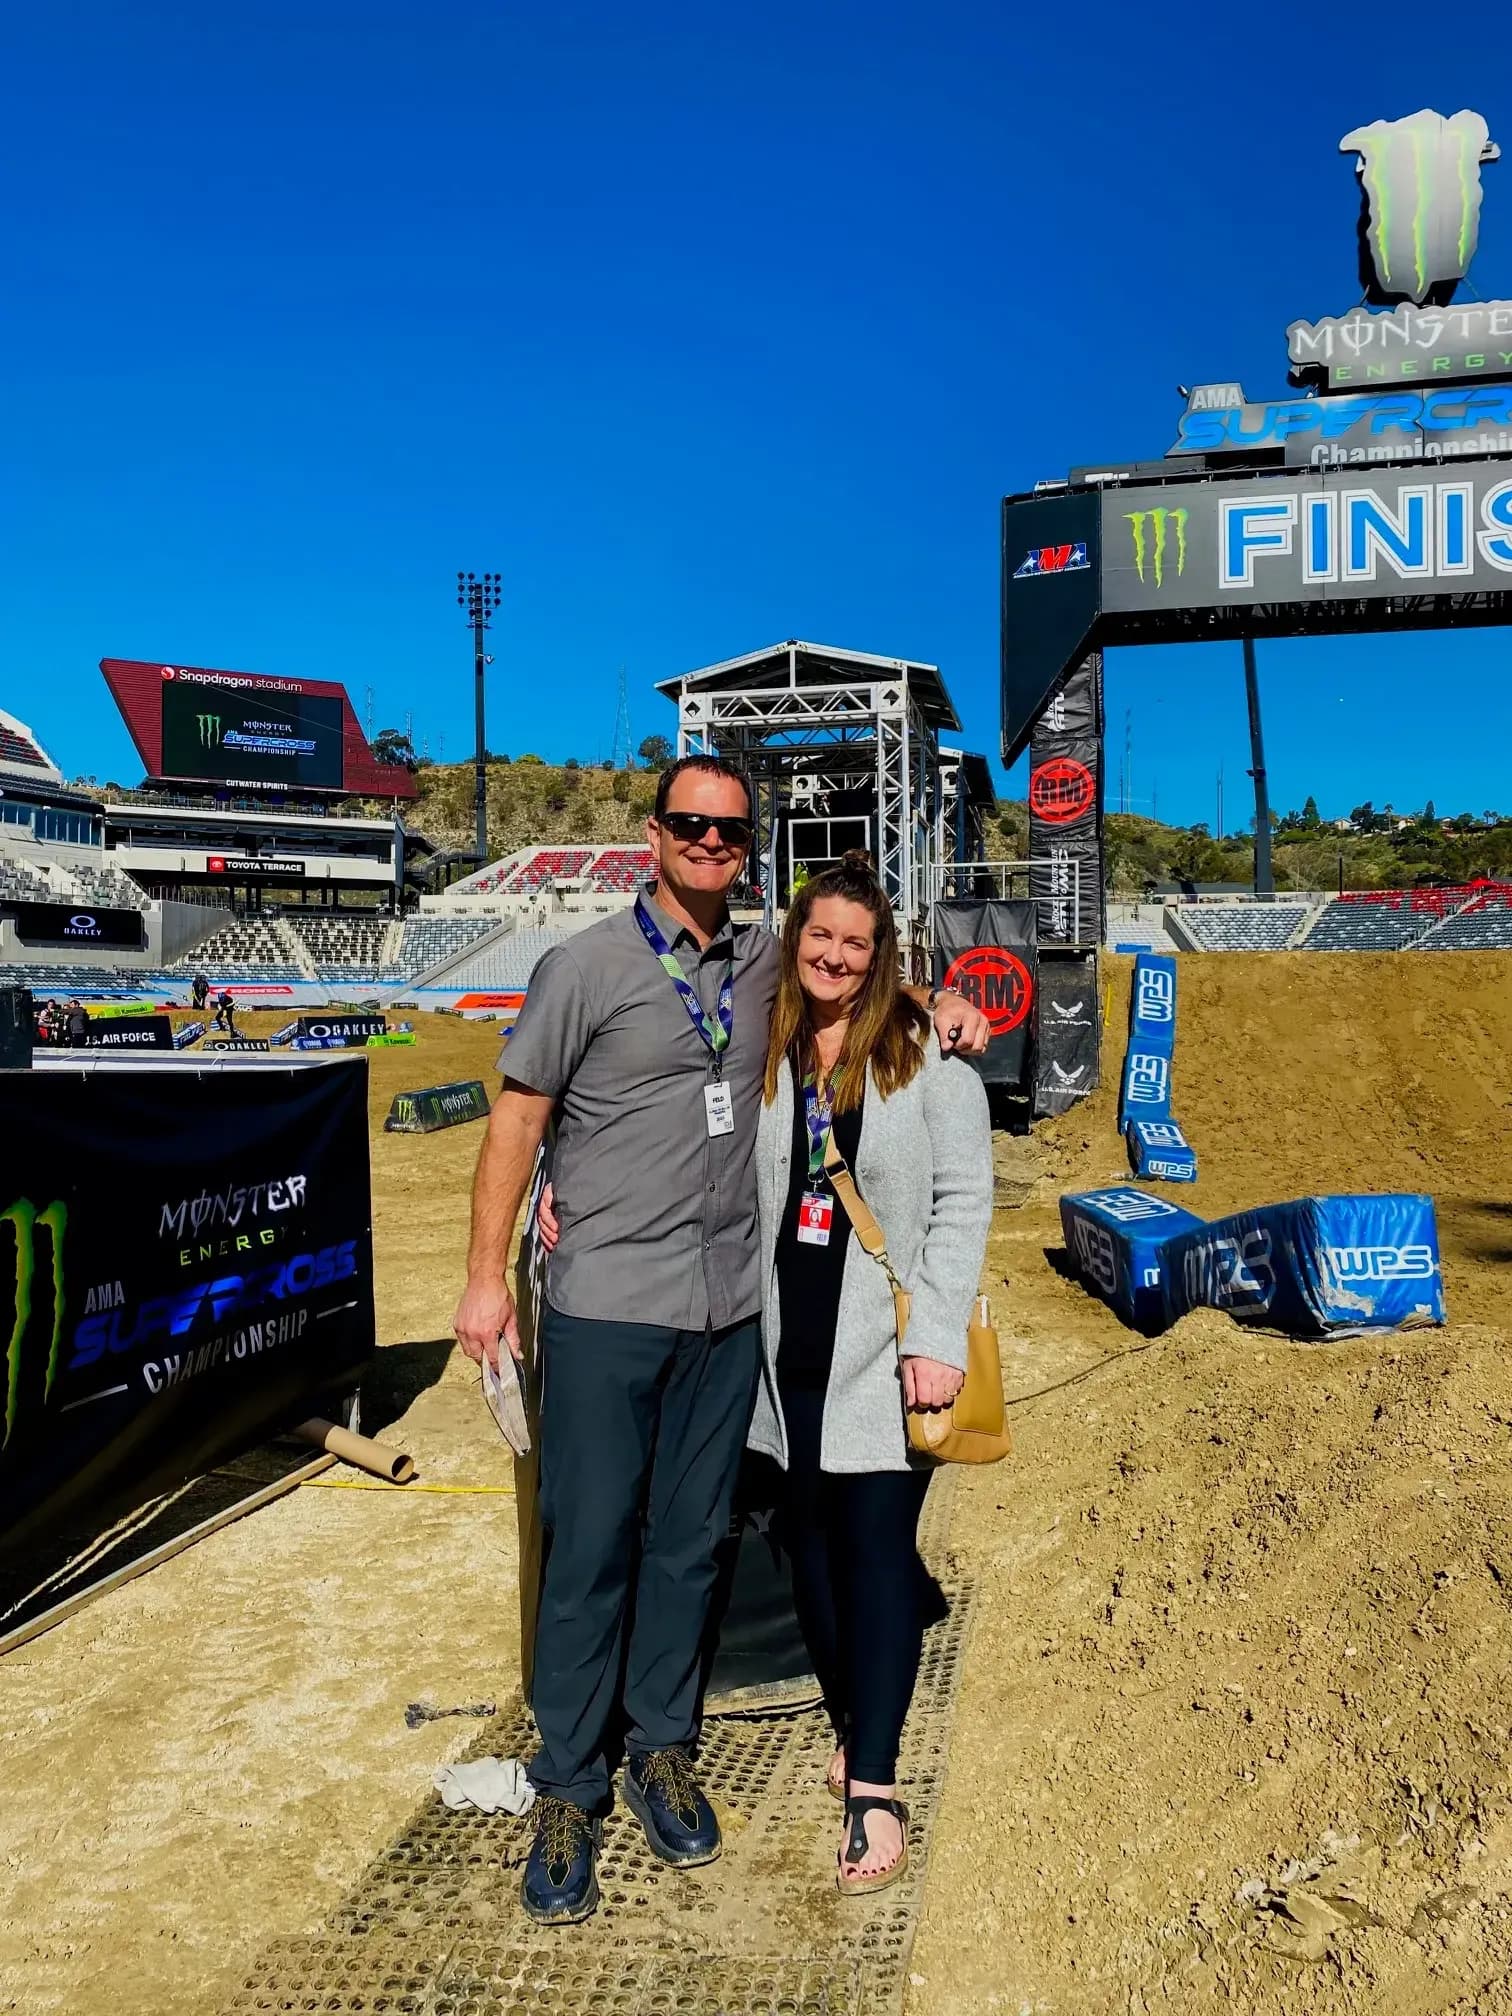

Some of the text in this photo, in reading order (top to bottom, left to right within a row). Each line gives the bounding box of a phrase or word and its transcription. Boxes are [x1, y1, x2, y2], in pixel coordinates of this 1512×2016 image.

[1191, 386, 1241, 410] AMA
[1012, 542, 1091, 576] AMA
[179, 669, 303, 692] Snapdragon stadium
[242, 720, 293, 733] MONSTER
[223, 733, 316, 751] SUPERCROSS
[243, 745, 297, 756] CHAMPIONSHIP
[225, 779, 289, 791] CUTWATER SPIRITS
[225, 861, 302, 872] TOYOTA TERRACE
[64, 927, 102, 936] OAKLEY
[962, 973, 1015, 1010] RM
[1138, 967, 1173, 1022] WPS
[101, 1033, 121, 1044] AIR
[121, 1031, 156, 1043] FORCE
[332, 1022, 385, 1036] OAKLEY
[229, 1041, 268, 1051] OAKLEY
[1127, 1053, 1168, 1104] WPS
[1148, 1159, 1193, 1178] WPS
[158, 1174, 307, 1241] MONSTER
[1325, 1245, 1434, 1281] WPS
[84, 1280, 126, 1315] AMA
[143, 1308, 308, 1394] CHAMPIONSHIP
